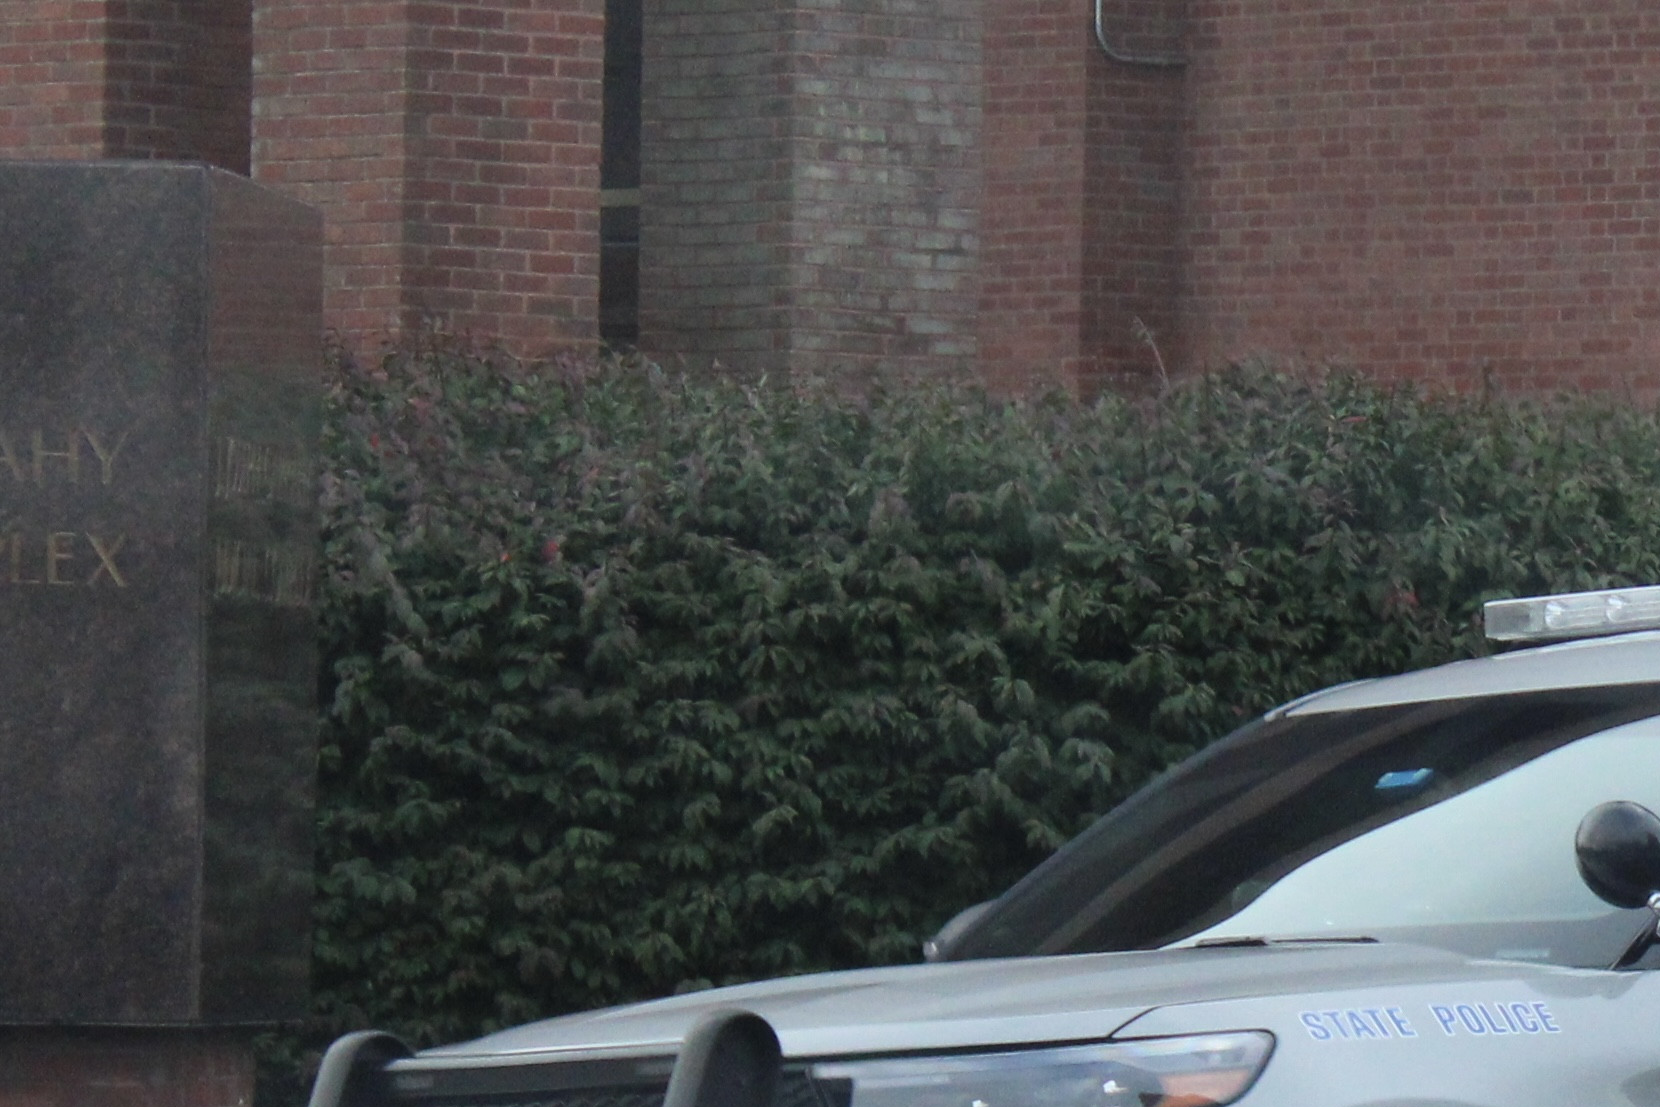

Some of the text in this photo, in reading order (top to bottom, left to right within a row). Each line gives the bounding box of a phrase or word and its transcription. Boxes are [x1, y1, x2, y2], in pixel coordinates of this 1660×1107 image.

[0, 531, 127, 587] LEX
[1299, 1000, 1561, 1042] STATE POLICE
